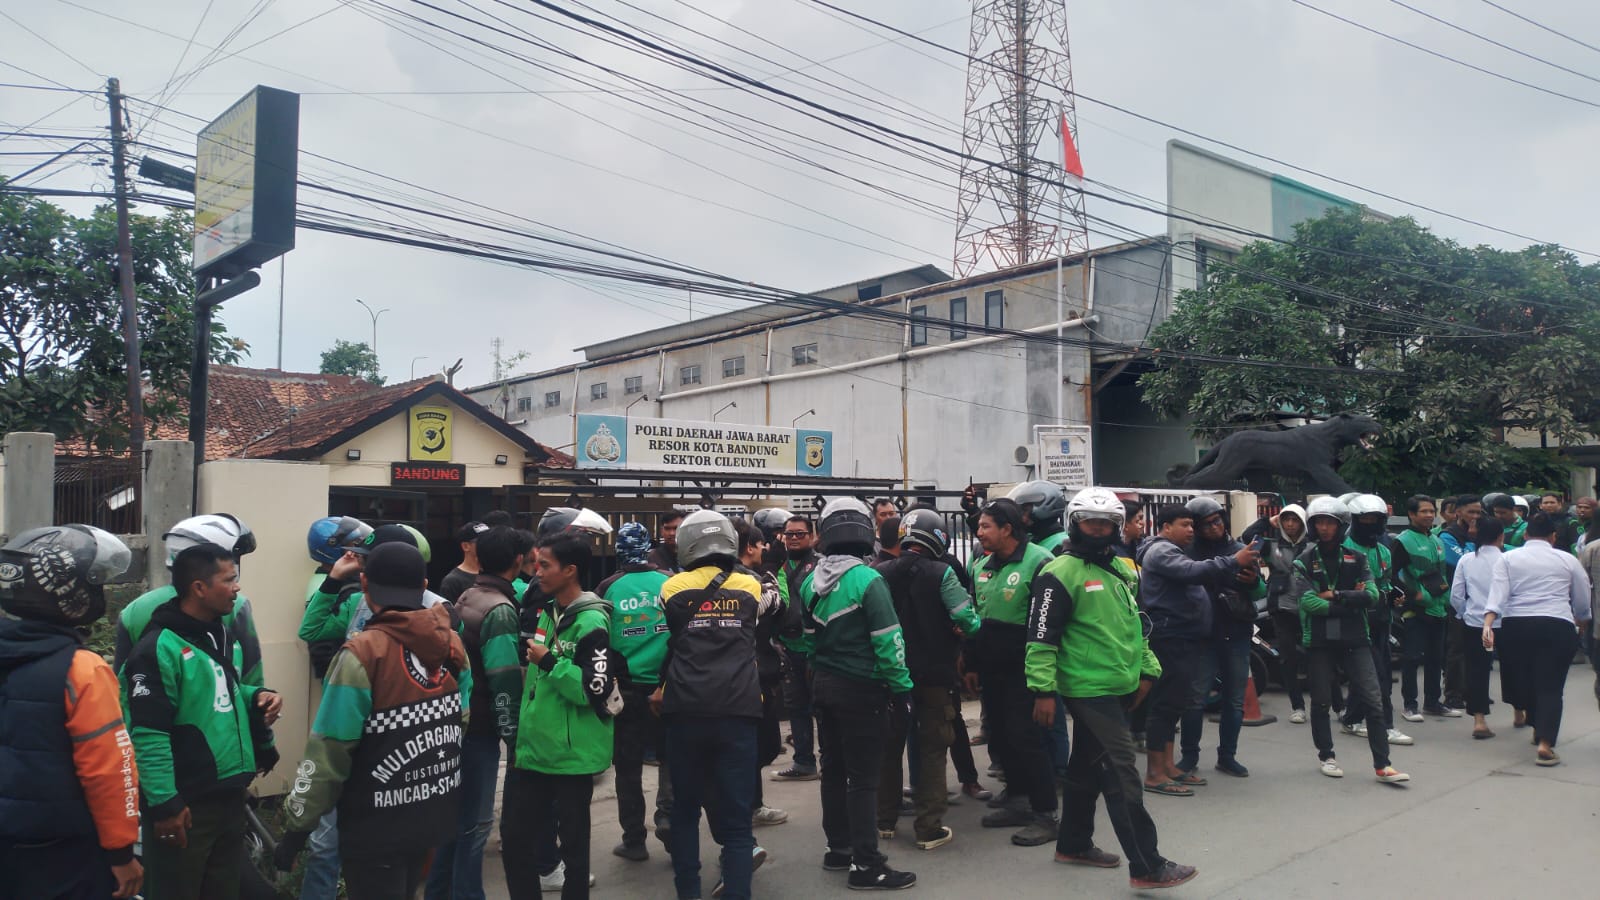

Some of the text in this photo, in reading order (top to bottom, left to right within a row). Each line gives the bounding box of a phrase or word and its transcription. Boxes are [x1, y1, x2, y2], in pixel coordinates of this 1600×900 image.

[635, 425, 791, 444] POLRI DAERAH JAWA BARAT
[648, 440, 779, 456] RESOR KOTA BANDUNG
[663, 454, 767, 468] SEKTOR CILEUNYI
[688, 596, 740, 611] axim
[1037, 588, 1054, 639] tokopedia
[120, 747, 139, 818] ShopeeFood
